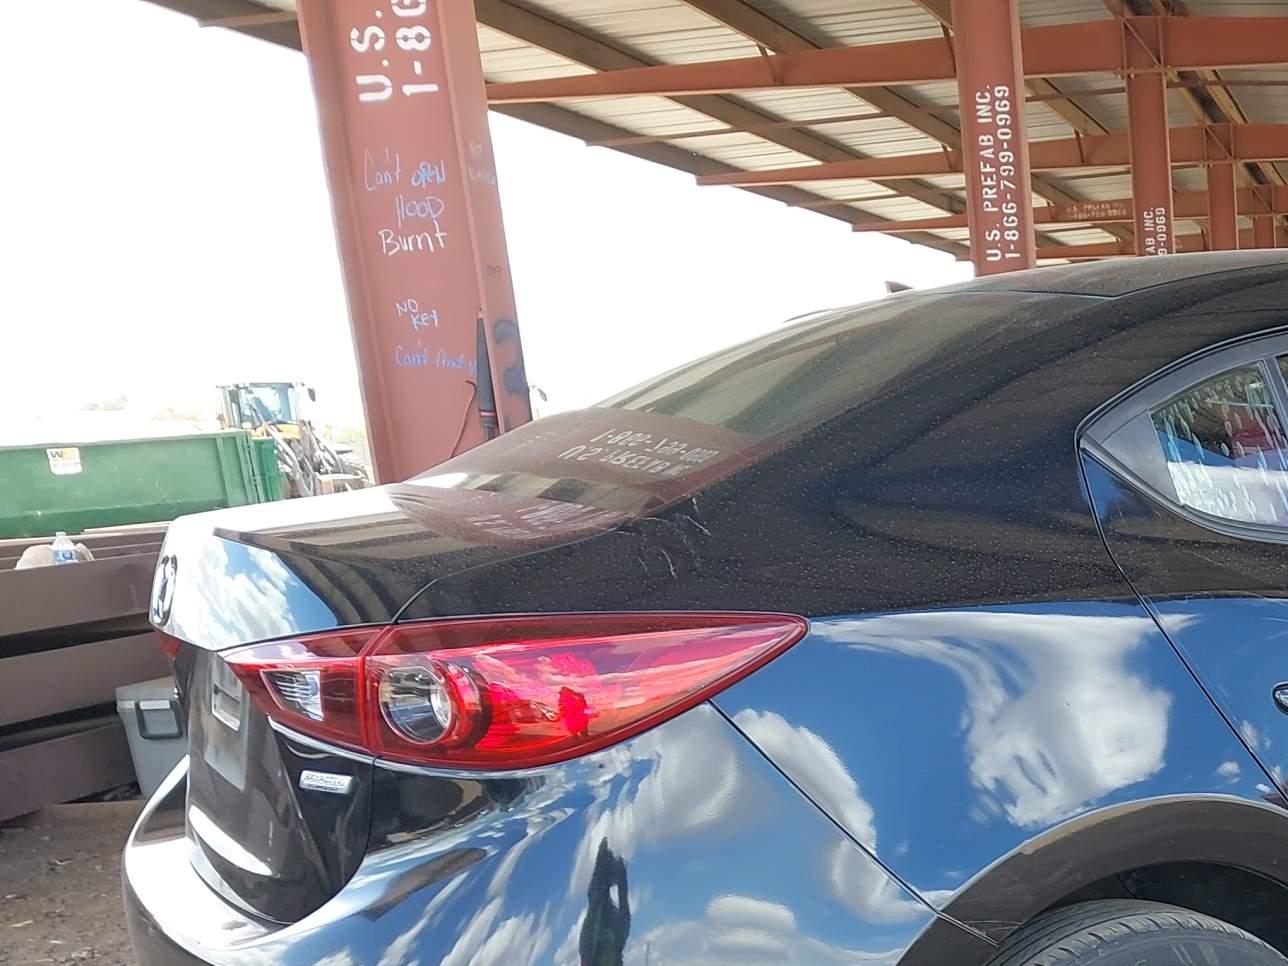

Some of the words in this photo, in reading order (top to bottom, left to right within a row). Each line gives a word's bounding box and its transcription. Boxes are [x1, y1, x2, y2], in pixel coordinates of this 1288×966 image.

[351, 10, 393, 102] U.S.
[976, 84, 993, 123] INC.
[979, 135, 999, 212] PREFAB
[994, 85, 1021, 259] 1-866-799-0969
[378, 218, 448, 256] Burnt
[1143, 206, 1155, 231] INC.
[985, 223, 1001, 262] U.S.
[395, 298, 419, 317] NO
[410, 308, 440, 331] KEY
